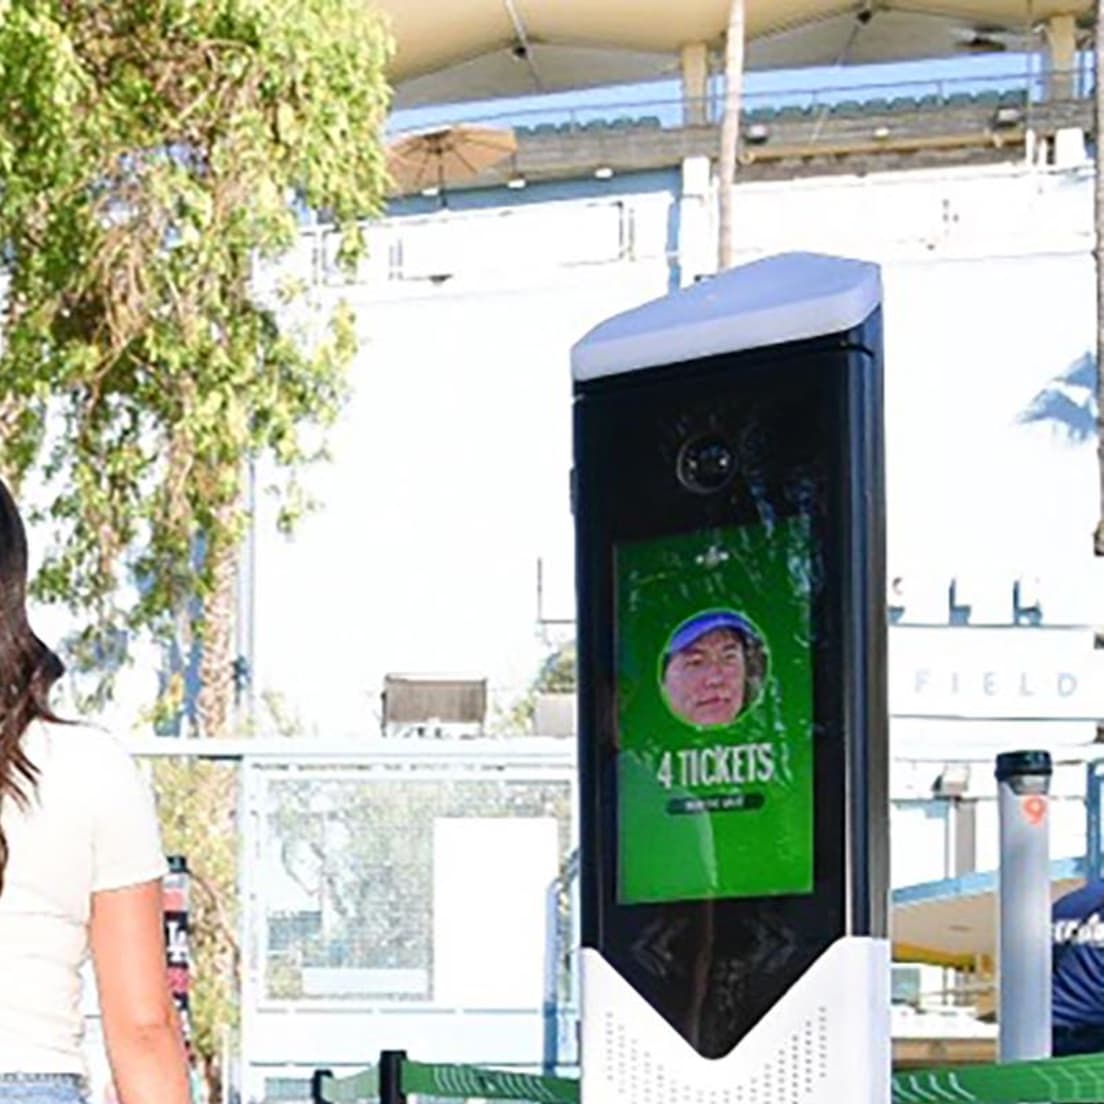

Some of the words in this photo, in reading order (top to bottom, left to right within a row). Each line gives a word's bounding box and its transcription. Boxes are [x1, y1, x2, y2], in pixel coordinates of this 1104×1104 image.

[914, 669, 1078, 698] FIELD
[657, 750, 672, 789] 4
[677, 743, 774, 786] TICKETS
